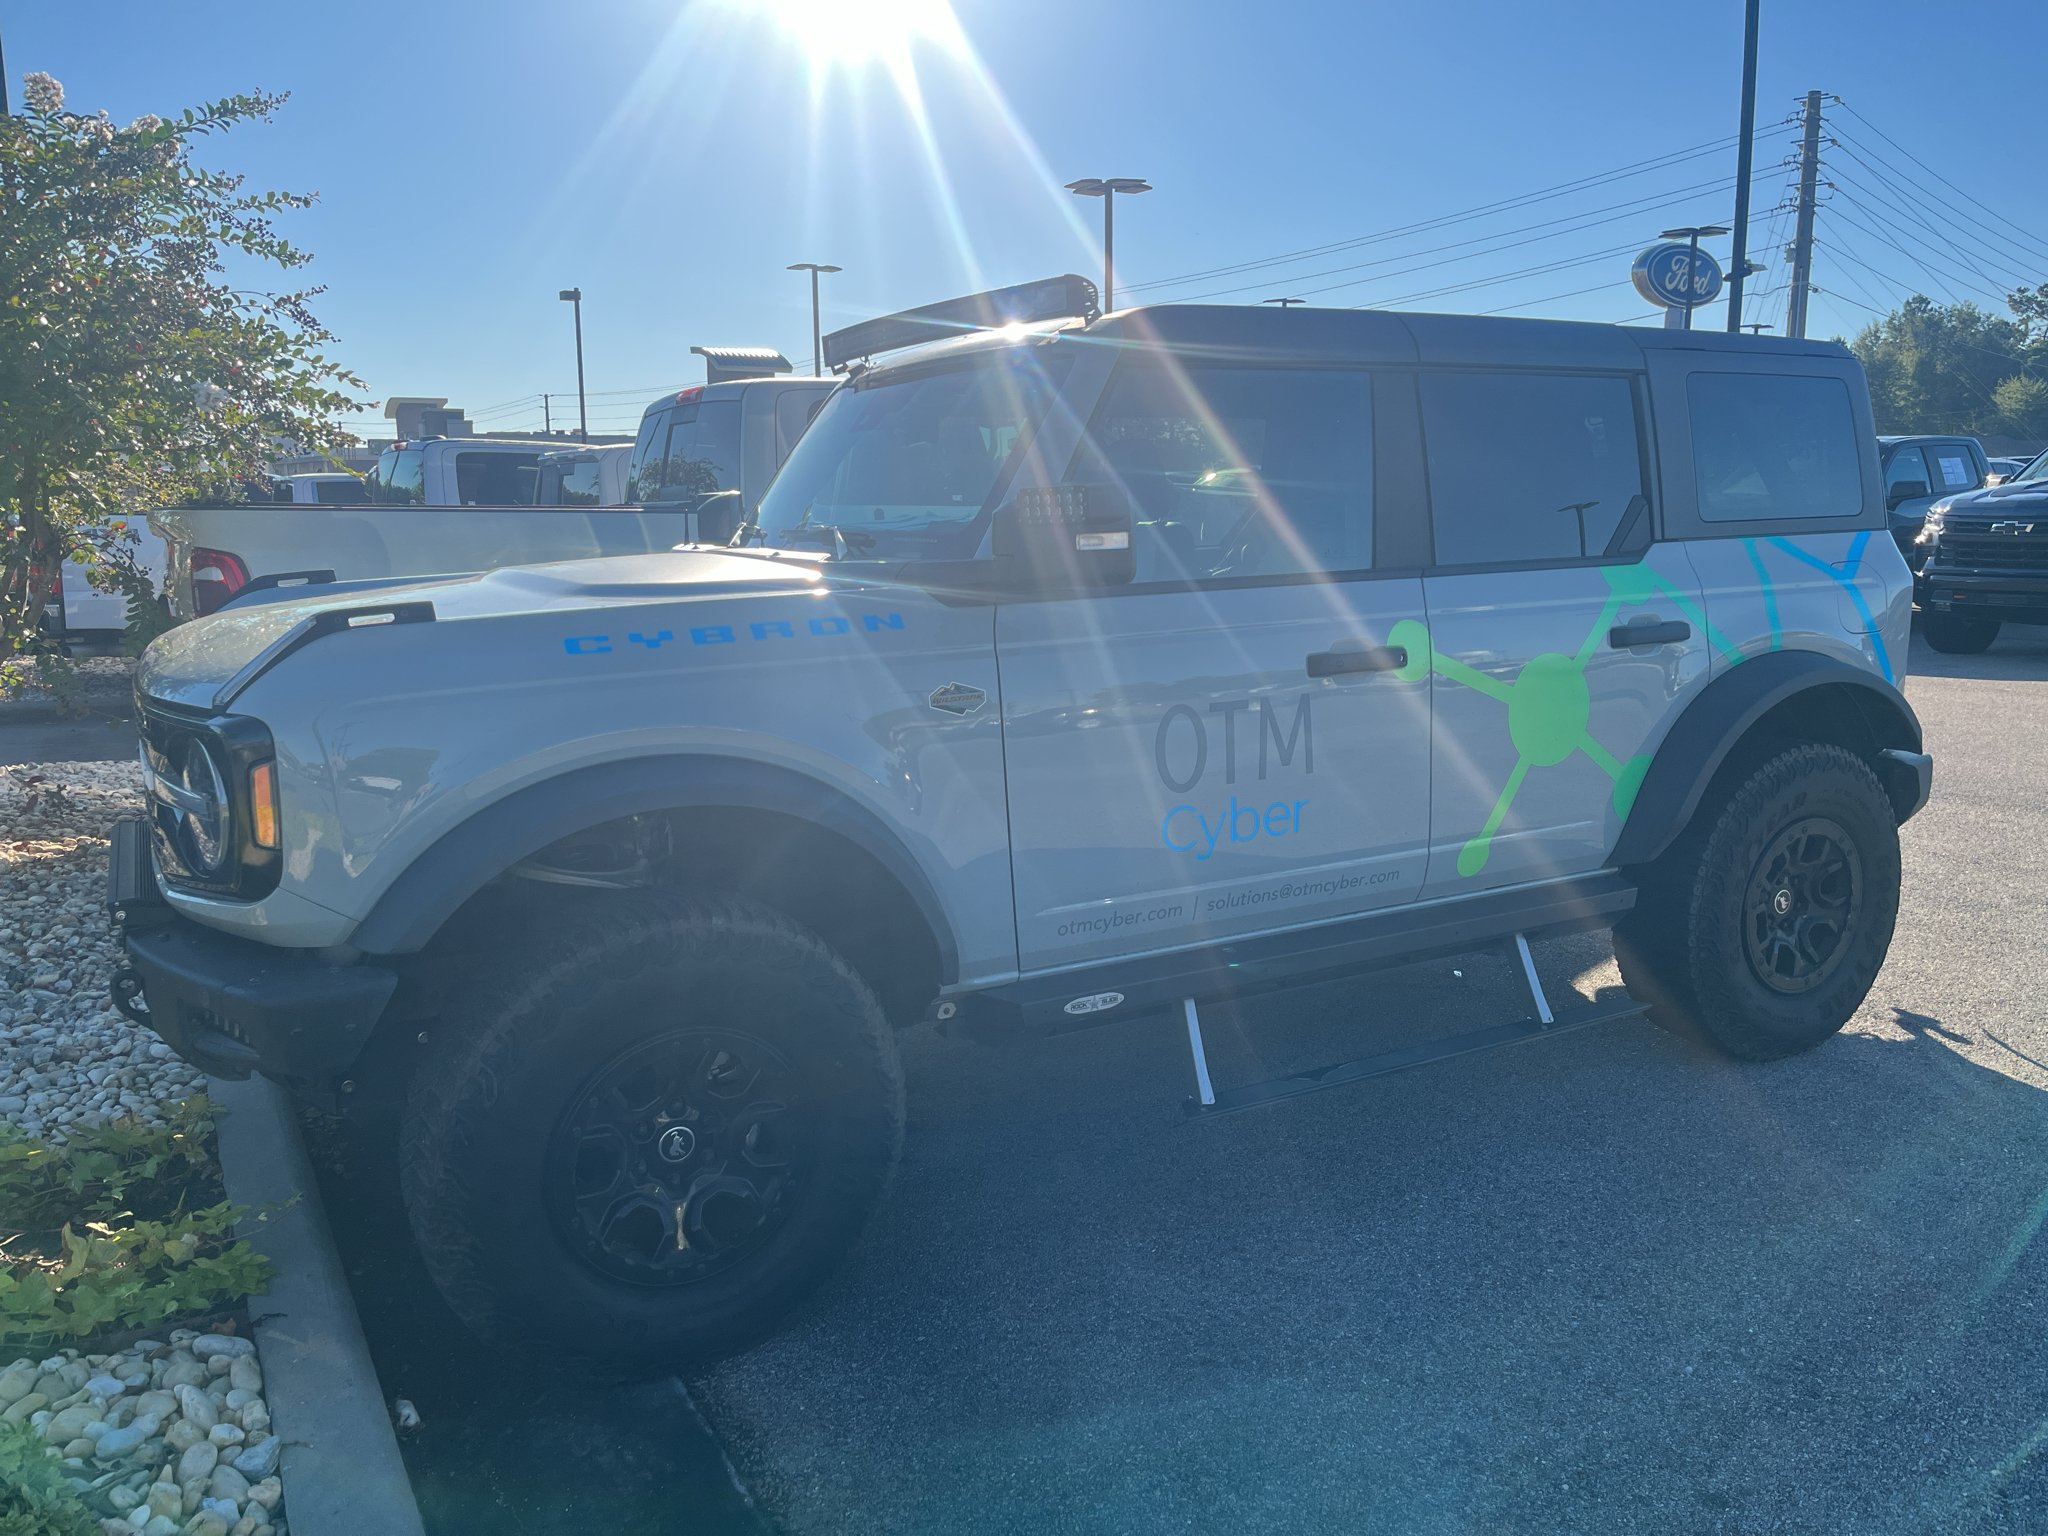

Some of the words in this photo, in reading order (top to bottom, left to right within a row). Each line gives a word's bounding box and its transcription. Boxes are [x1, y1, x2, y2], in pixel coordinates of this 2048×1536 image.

[563, 612, 906, 656] CYBRON
[1155, 692, 1314, 794] OTM
[1161, 794, 1310, 861] Cyber
[1057, 906, 1183, 937] otmcyber.com
[1207, 870, 1400, 912] solutions@otmcyber.com
